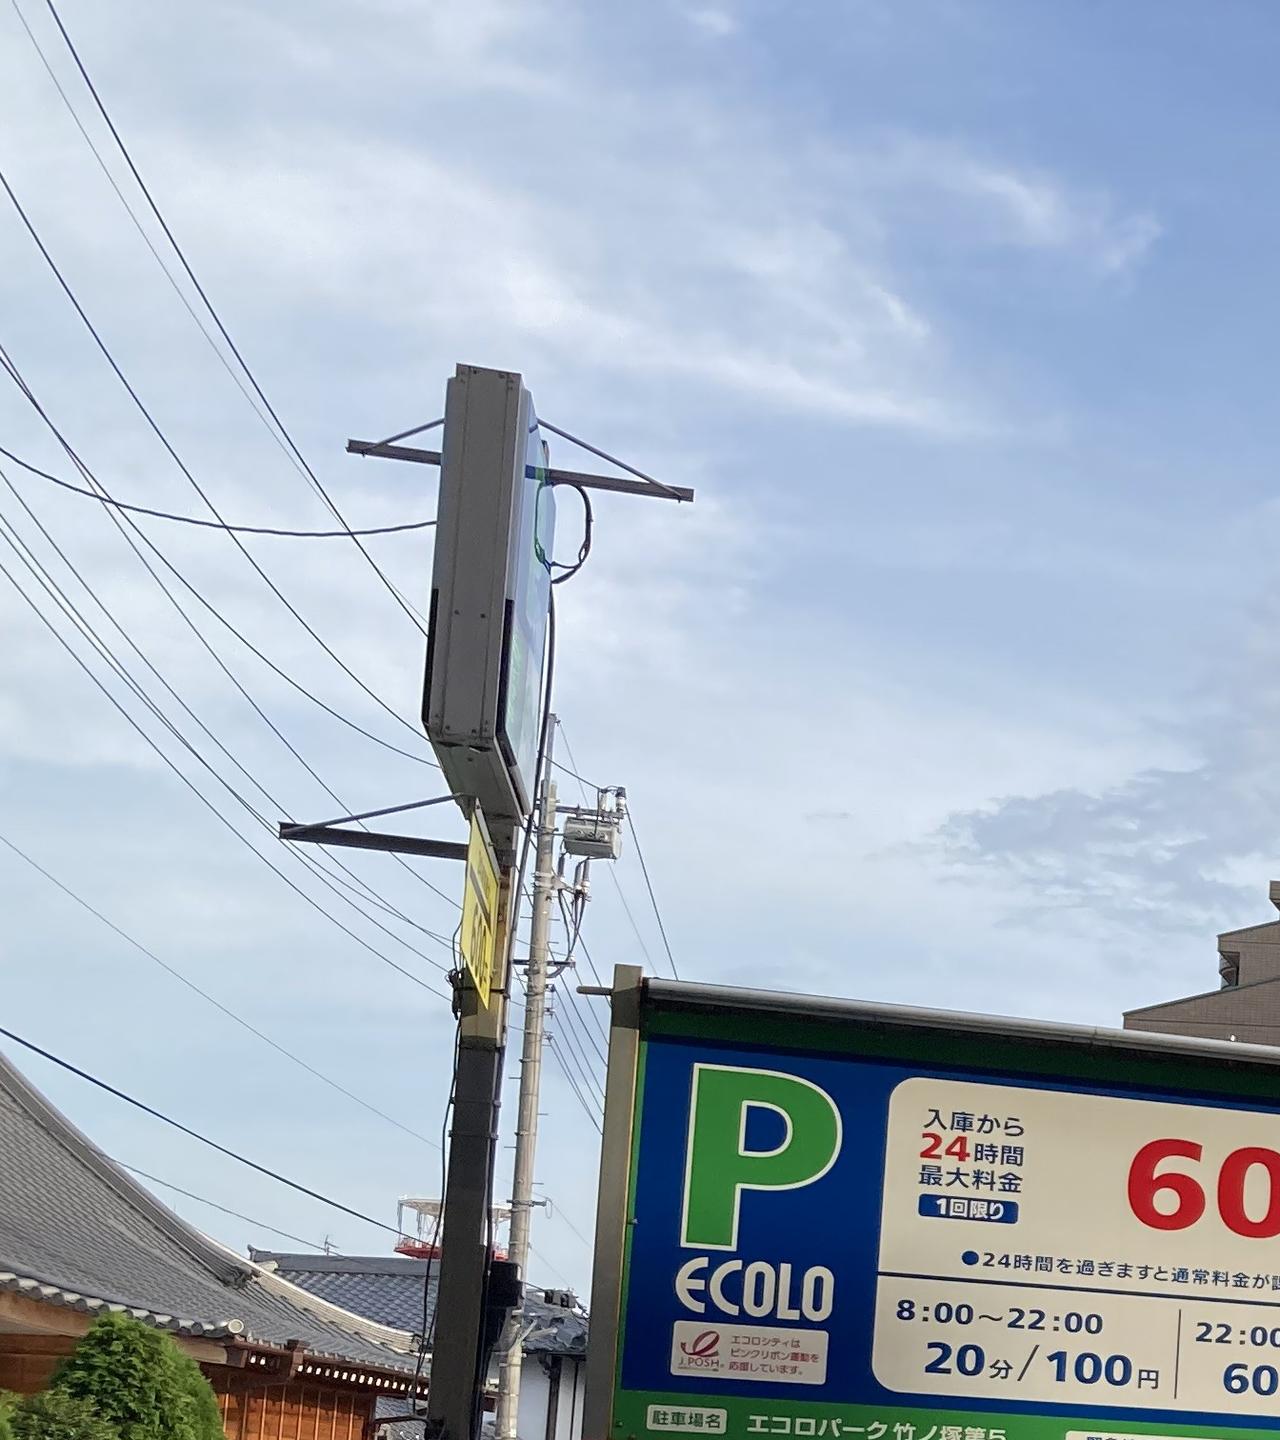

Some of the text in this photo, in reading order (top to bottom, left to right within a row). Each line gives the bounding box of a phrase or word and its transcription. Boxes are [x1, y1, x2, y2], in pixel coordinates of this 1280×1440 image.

[924, 1108, 1025, 1137] 入庫から
[680, 1062, 843, 1251] P
[919, 1132, 1025, 1167] 24時間
[918, 1164, 1023, 1193] 最大料金
[936, 1197, 1004, 1220] 1回限り
[675, 1257, 835, 1322] ECOLO
[730, 1335, 801, 1349] エコロシティは
[651, 1409, 722, 1429] 駐車場名
